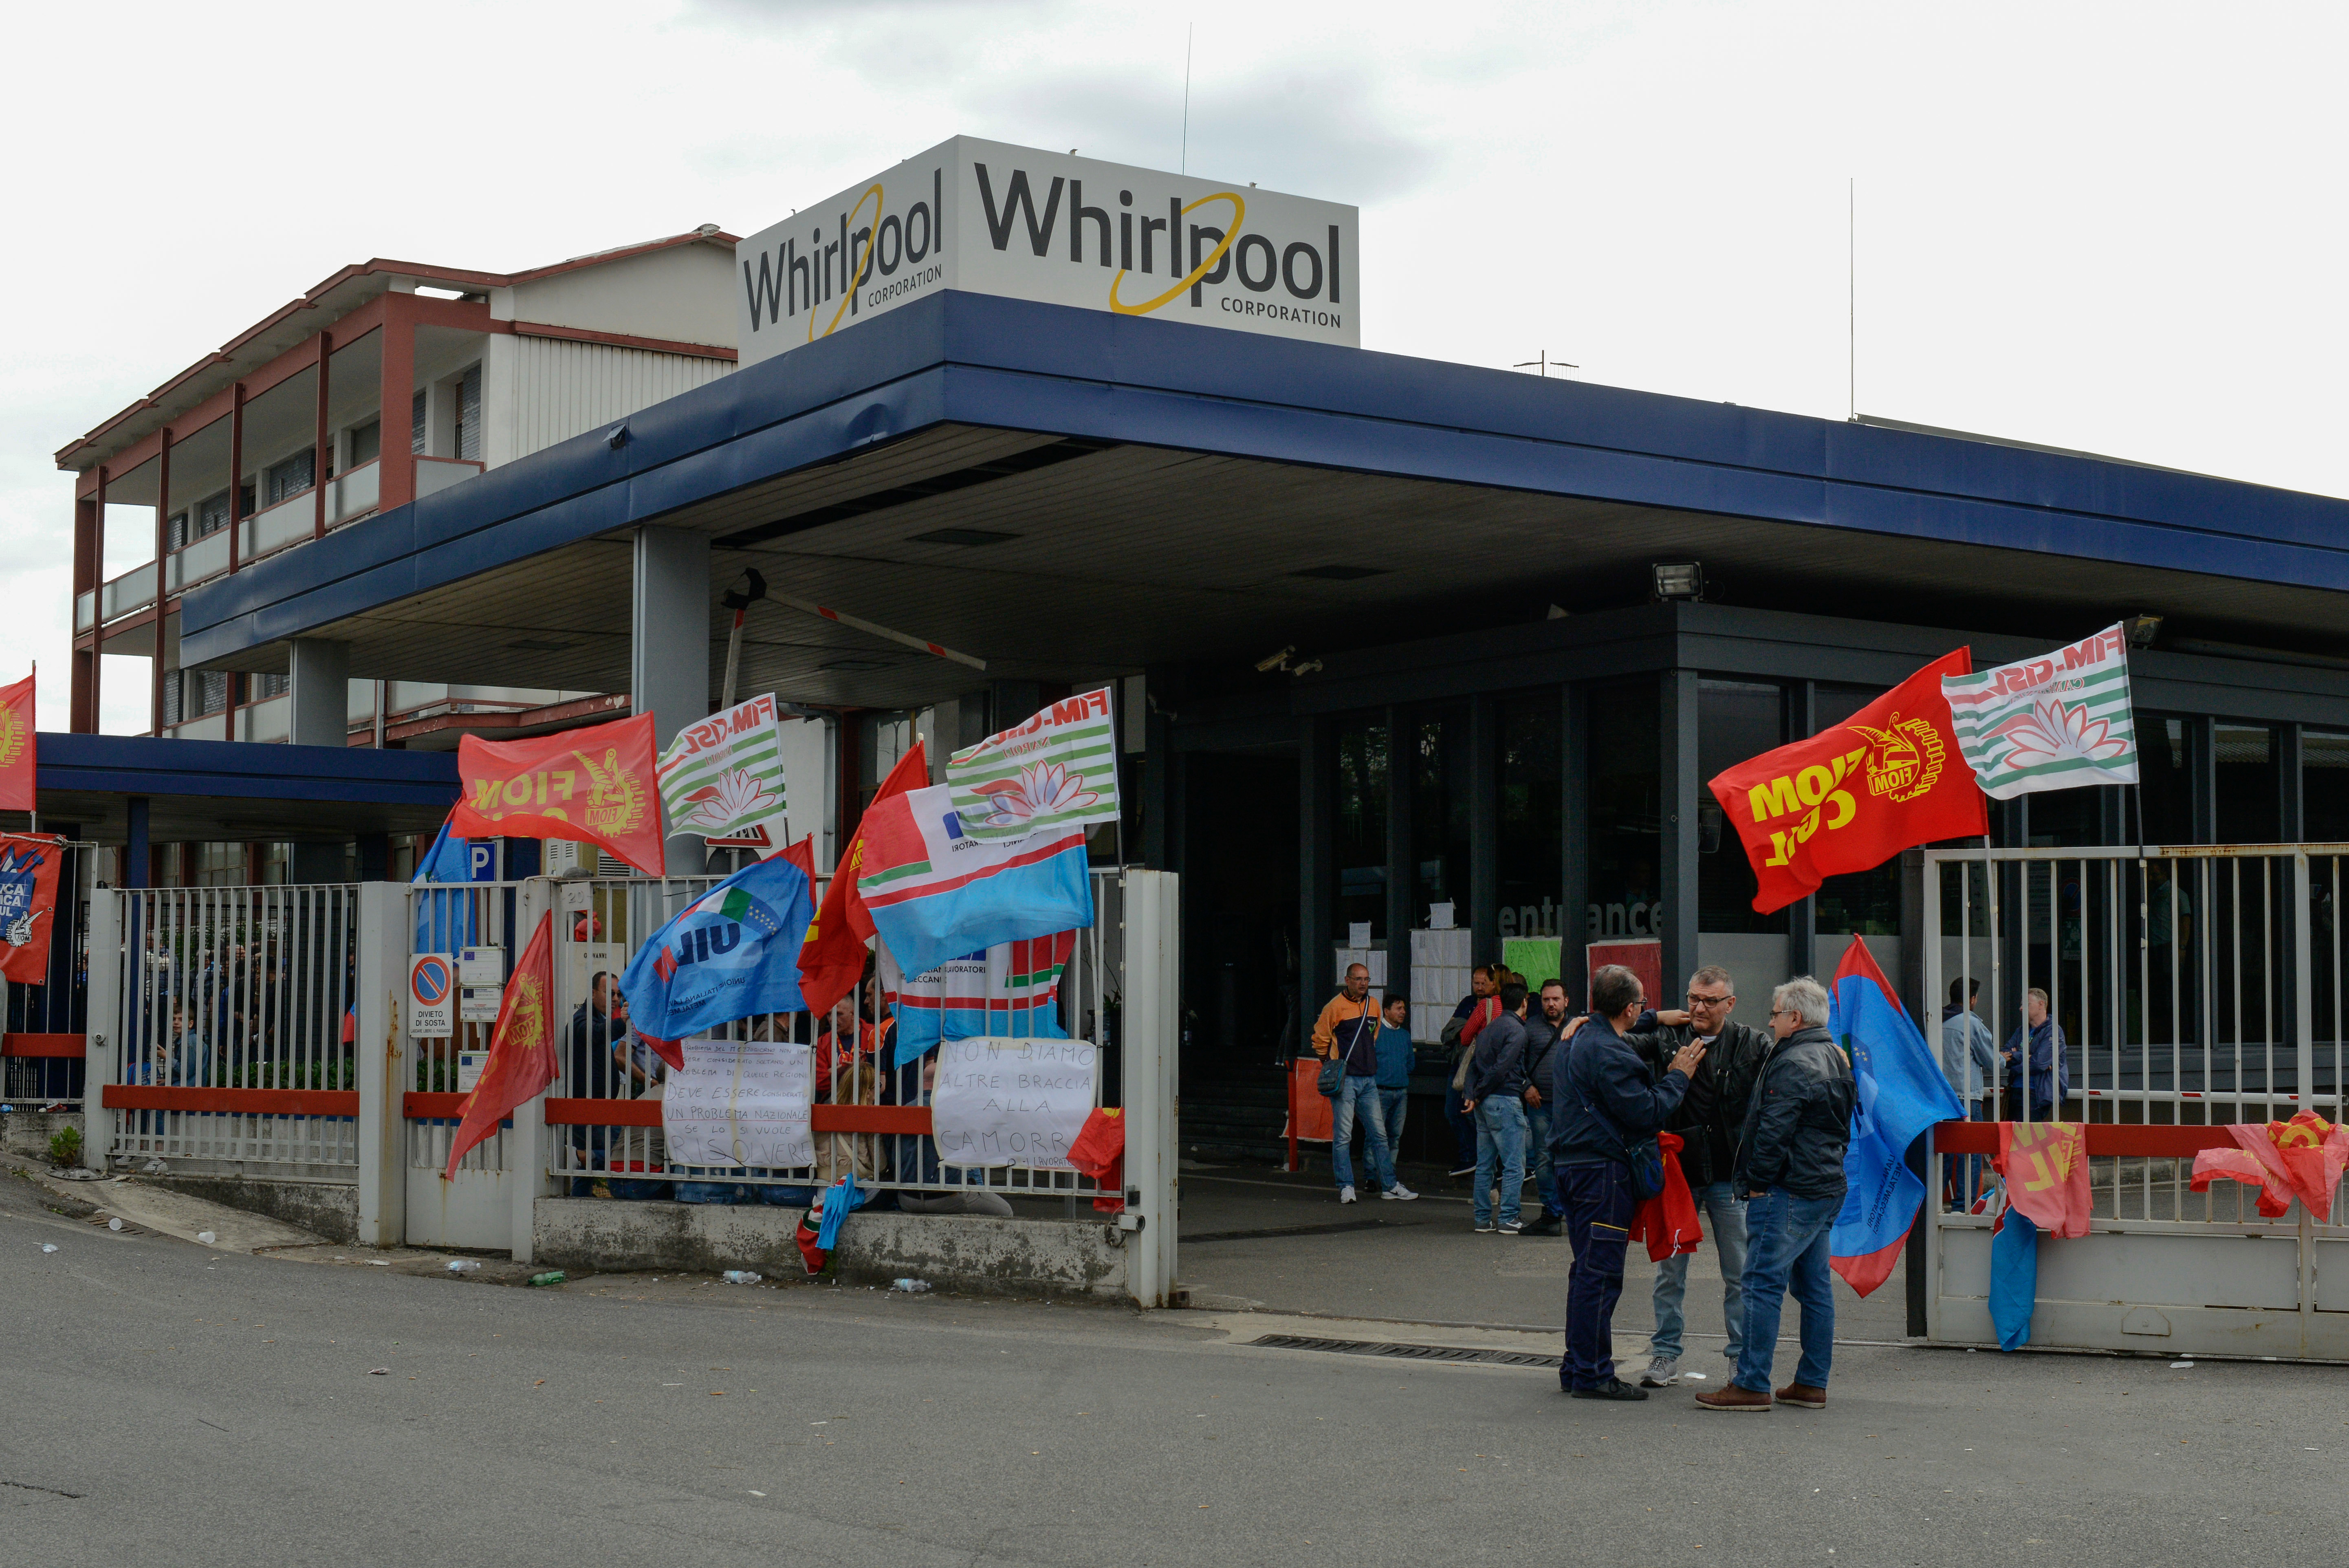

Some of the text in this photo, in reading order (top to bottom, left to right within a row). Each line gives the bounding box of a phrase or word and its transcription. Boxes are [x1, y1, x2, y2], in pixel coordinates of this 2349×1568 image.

[974, 162, 1341, 308] Whirlpool
[743, 167, 941, 333] Whirlpool
[868, 264, 941, 308] CORPORATION
[1221, 297, 1341, 328] CORPORATION
[471, 848, 489, 879] P
[568, 890, 584, 903] 20
[685, 1041, 711, 1051] PROBLEMA
[945, 1041, 1094, 1065] NON DIAMO
[666, 1082, 703, 1101] DEVE
[711, 1087, 760, 1099] ESSERE
[939, 1073, 1090, 1090] ALTRE BRACCIA
[666, 1106, 808, 1120] UN PROBLEMA NAZIONALE
[983, 1099, 1051, 1113] ALLA
[685, 1125, 698, 1134] SE
[755, 1126, 791, 1134] VUOLE
[671, 1135, 813, 1164] RISOLVERE
[940, 1130, 1070, 1153] CAMORR
